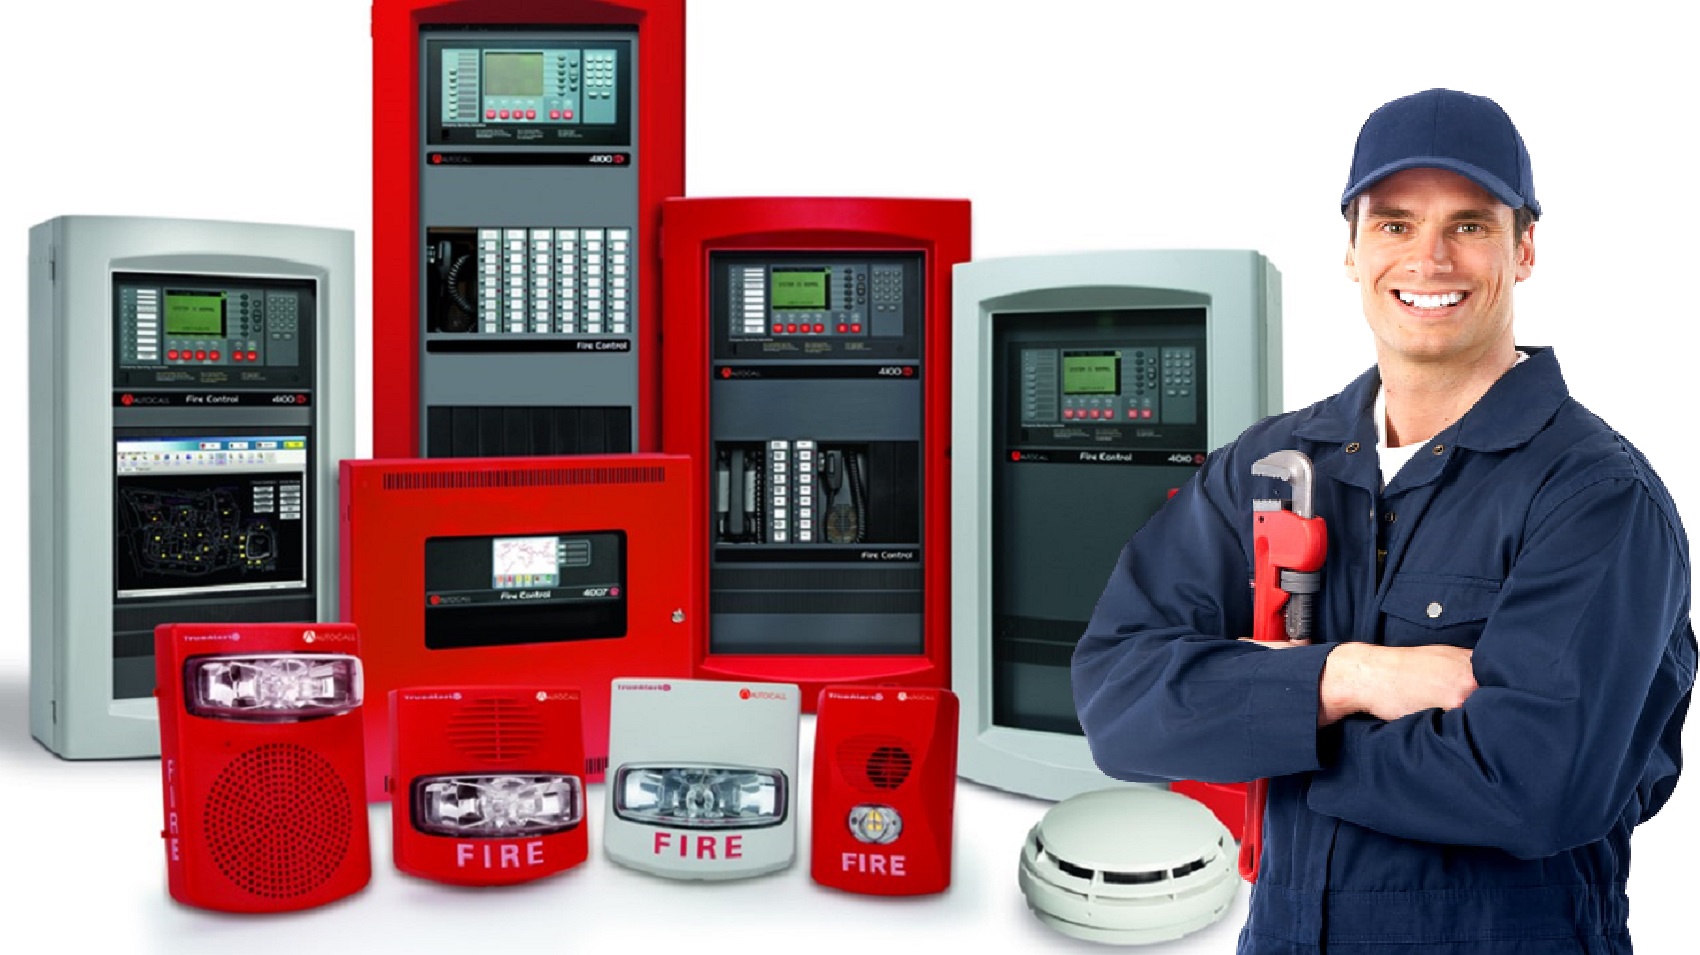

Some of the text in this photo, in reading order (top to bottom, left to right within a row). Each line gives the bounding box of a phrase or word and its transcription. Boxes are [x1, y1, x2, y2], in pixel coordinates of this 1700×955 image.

[576, 341, 628, 351] Fire Control
[185, 395, 204, 404] Fire
[206, 395, 239, 404] Control
[1079, 451, 1098, 461] Fire
[1099, 452, 1133, 462] Control
[861, 551, 913, 560] Fire Control
[500, 591, 518, 601] Fire
[519, 590, 551, 600] Control
[315, 634, 356, 642] AUTOCALL
[750, 691, 788, 701] AUTOCALL
[167, 759, 180, 862] FIRE
[653, 832, 743, 860] FIRE
[456, 841, 545, 868] FIRE
[842, 853, 906, 876] FIRE
